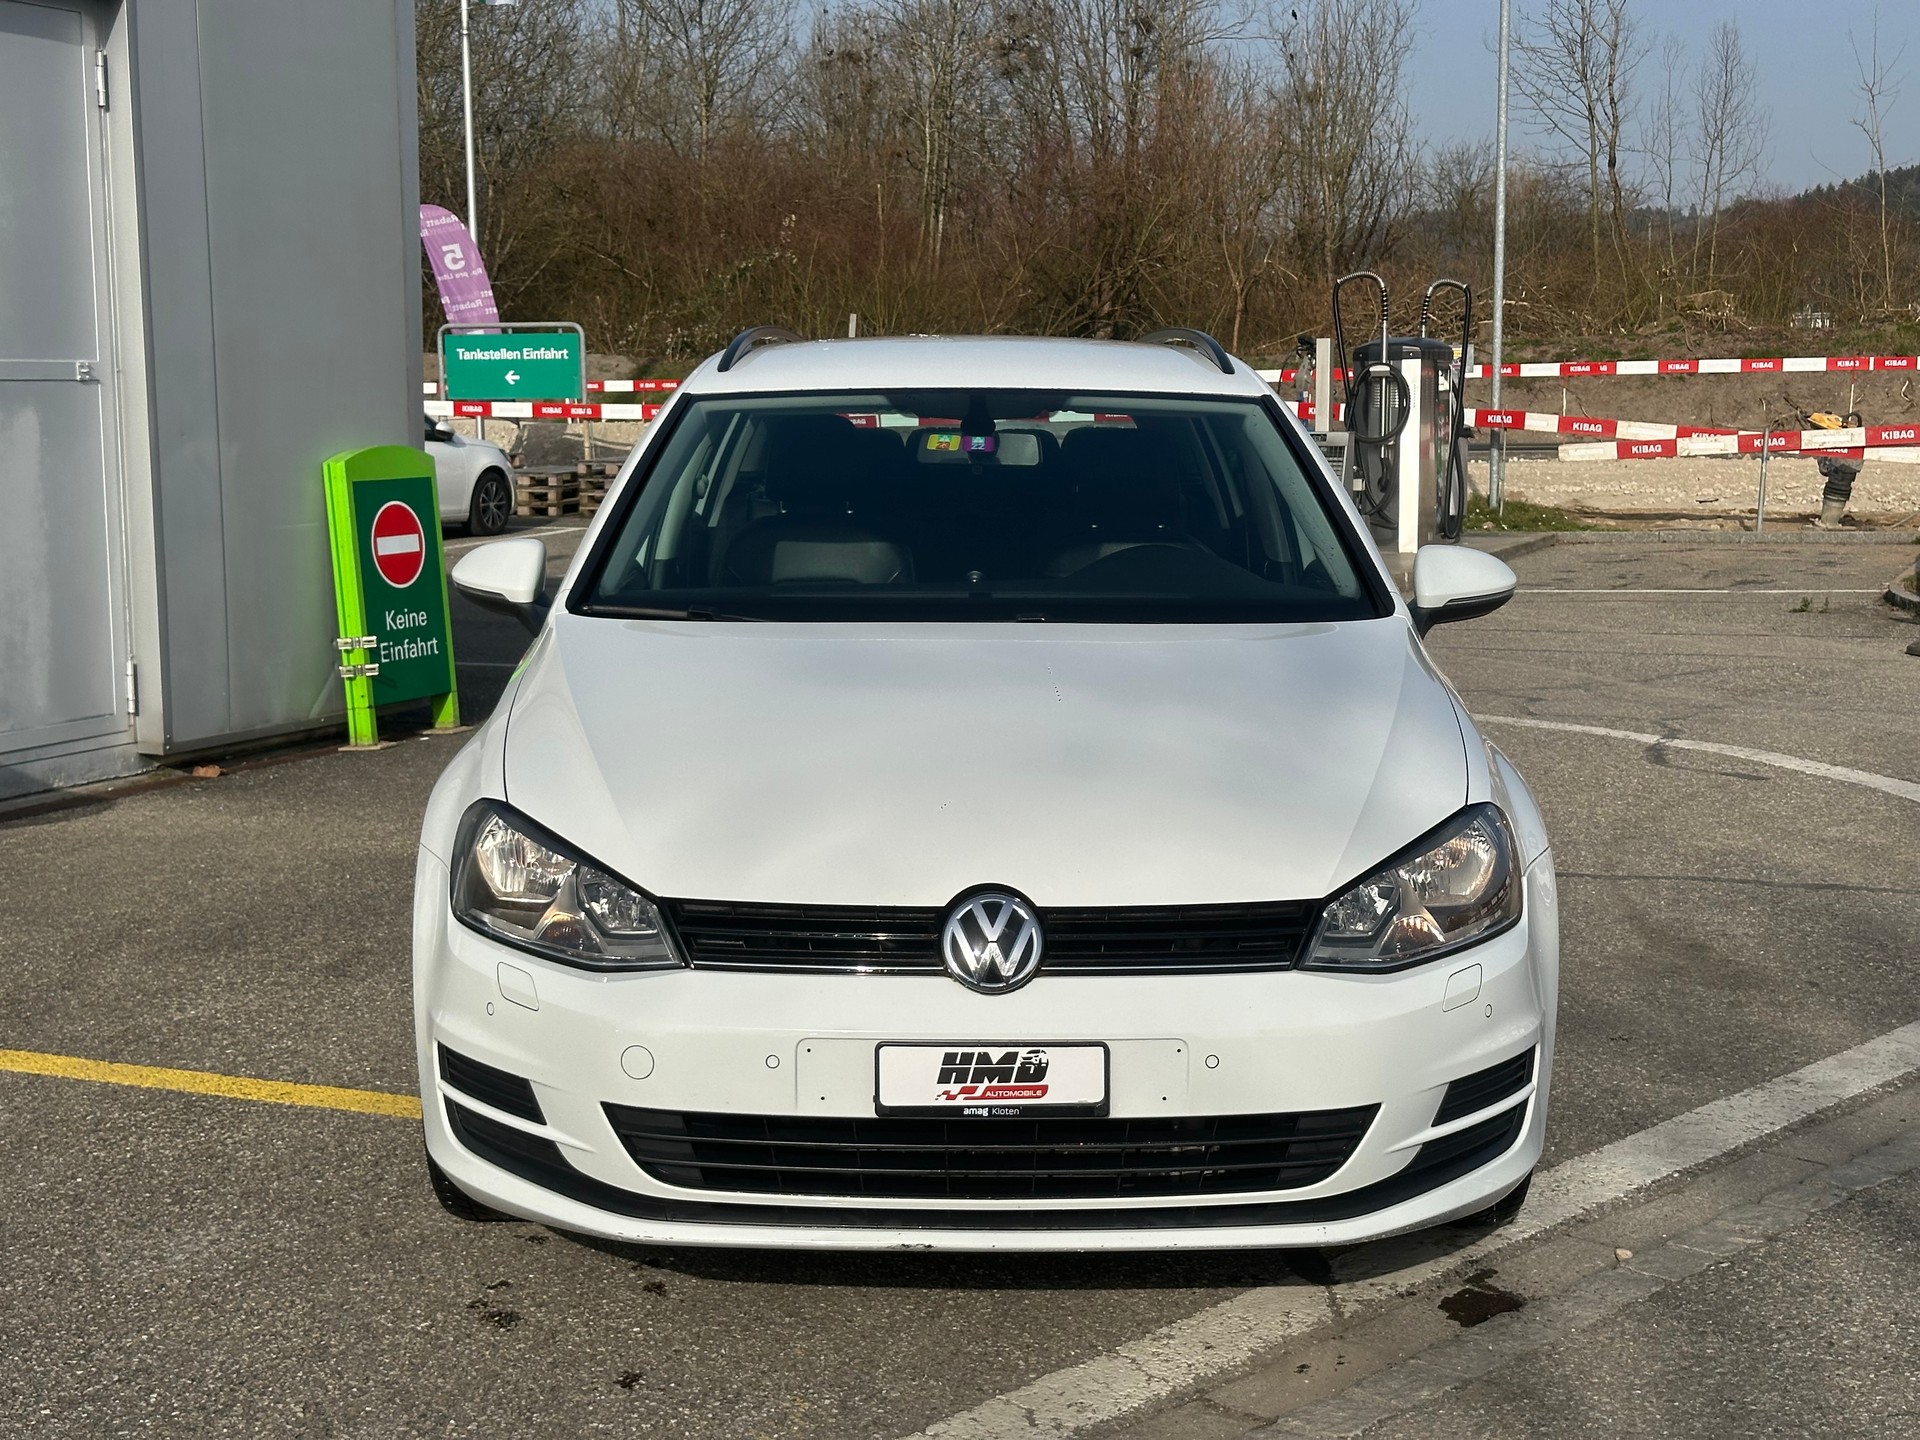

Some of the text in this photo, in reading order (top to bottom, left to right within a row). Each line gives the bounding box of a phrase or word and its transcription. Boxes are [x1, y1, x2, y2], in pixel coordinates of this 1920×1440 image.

[456, 347, 569, 361] Tankstellen Einfahrt
[1667, 363, 1690, 371] KIBAG
[1751, 361, 1774, 369] KIBAG
[1885, 359, 1908, 367] KIBAG
[461, 405, 483, 413] KIBAG
[541, 406, 563, 414] KIBAG
[1572, 422, 1603, 432] KIBAG
[1881, 429, 1915, 440] KIBAG
[1631, 444, 1662, 454] KIBAG
[385, 609, 428, 631] Keine
[380, 636, 439, 663] Einfahrt
[947, 897, 1037, 984] VW
[985, 1089, 1043, 1098] AUTOMOBILE
[963, 1107, 1020, 1117] amag Kloten
